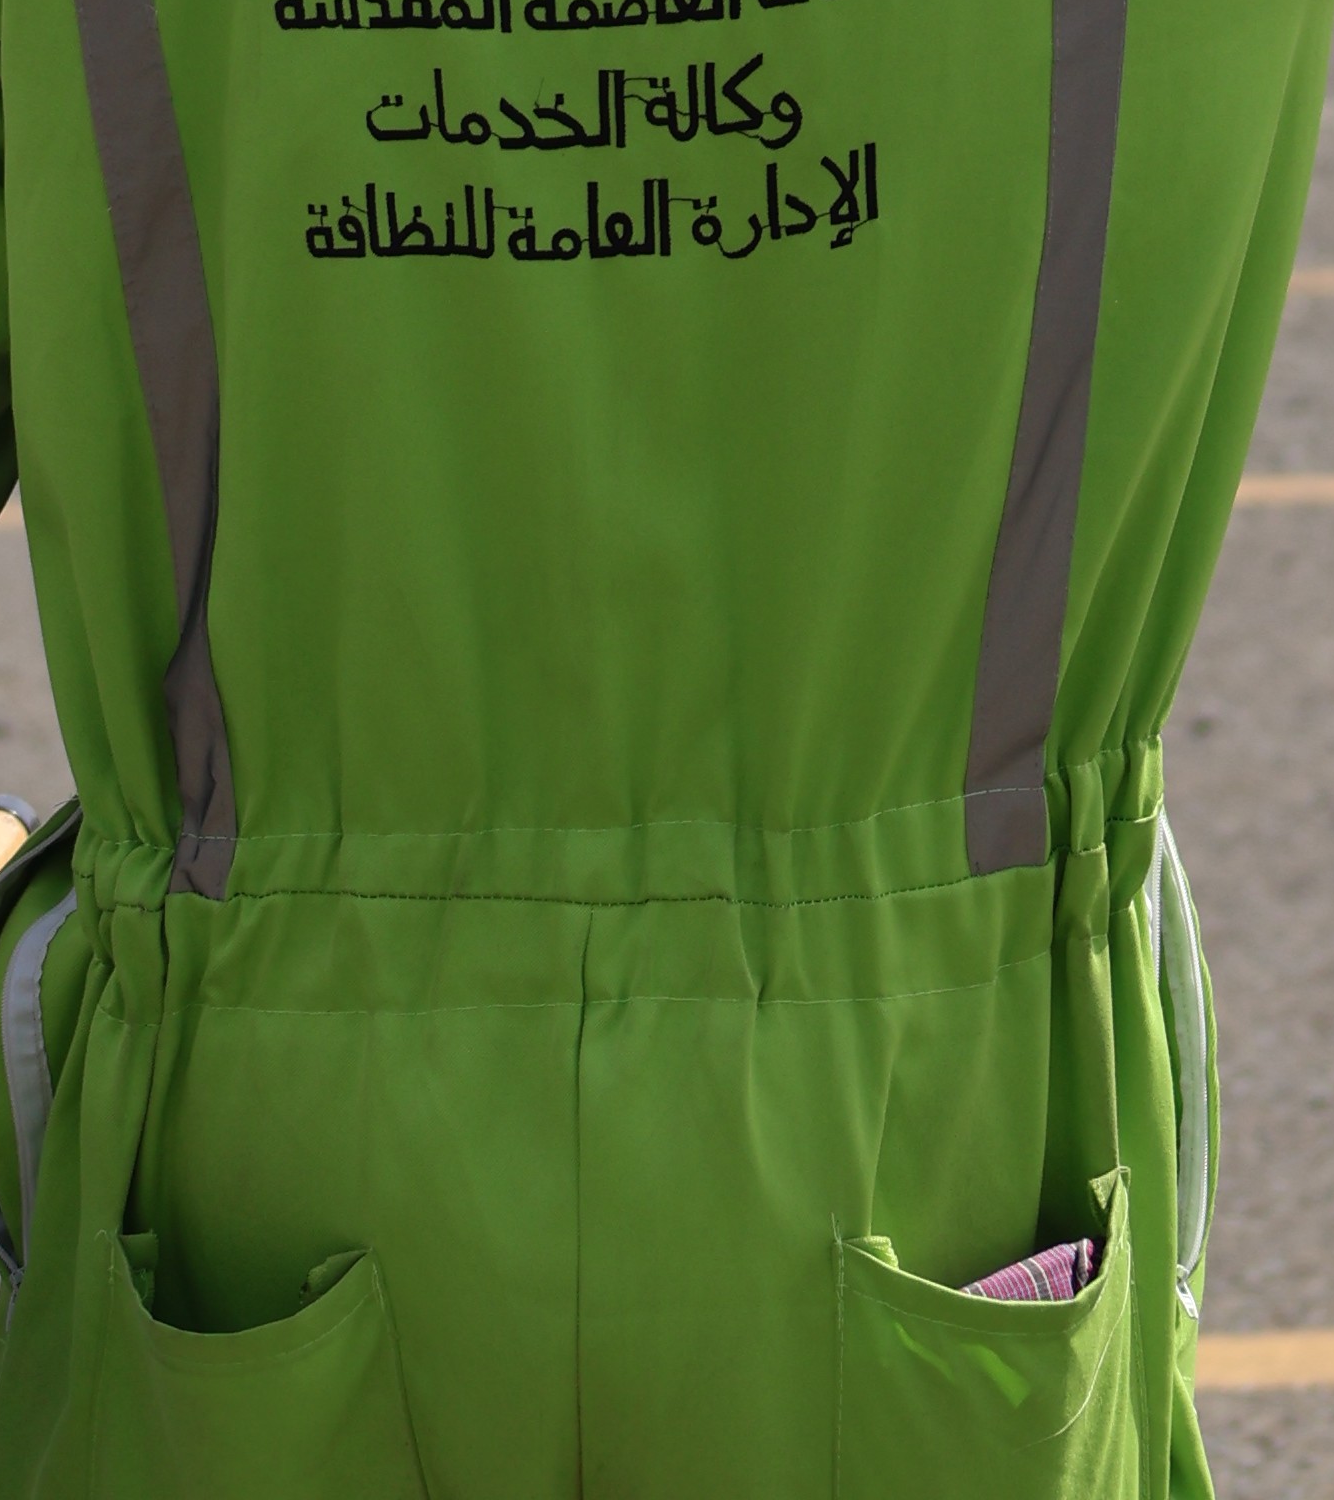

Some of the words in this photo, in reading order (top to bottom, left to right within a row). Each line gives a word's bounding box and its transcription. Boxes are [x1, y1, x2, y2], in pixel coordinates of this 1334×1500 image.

[366, 68, 625, 150] الخدمات
[644, 53, 803, 150] وكالة
[305, 181, 495, 259] للنظافة
[508, 179, 670, 260] العامة
[691, 142, 878, 259] الإدارة
